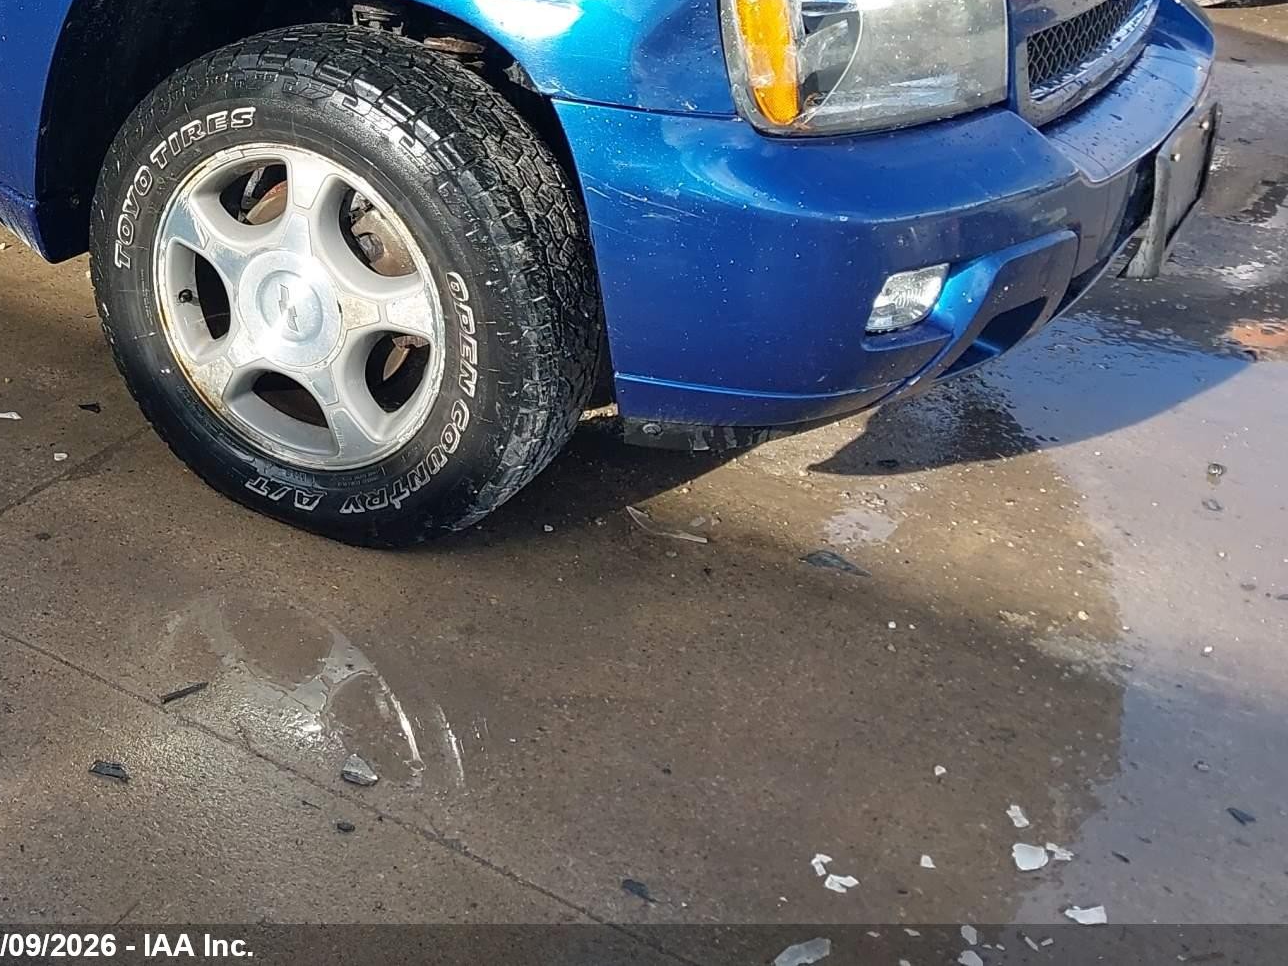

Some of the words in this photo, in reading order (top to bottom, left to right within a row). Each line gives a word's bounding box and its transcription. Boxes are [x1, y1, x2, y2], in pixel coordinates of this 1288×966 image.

[114, 165, 153, 270] TOYO
[149, 107, 256, 170] TIRES
[446, 271, 479, 399] OPEN
[244, 475, 328, 511] A/T
[339, 399, 470, 514] COUNTRY
